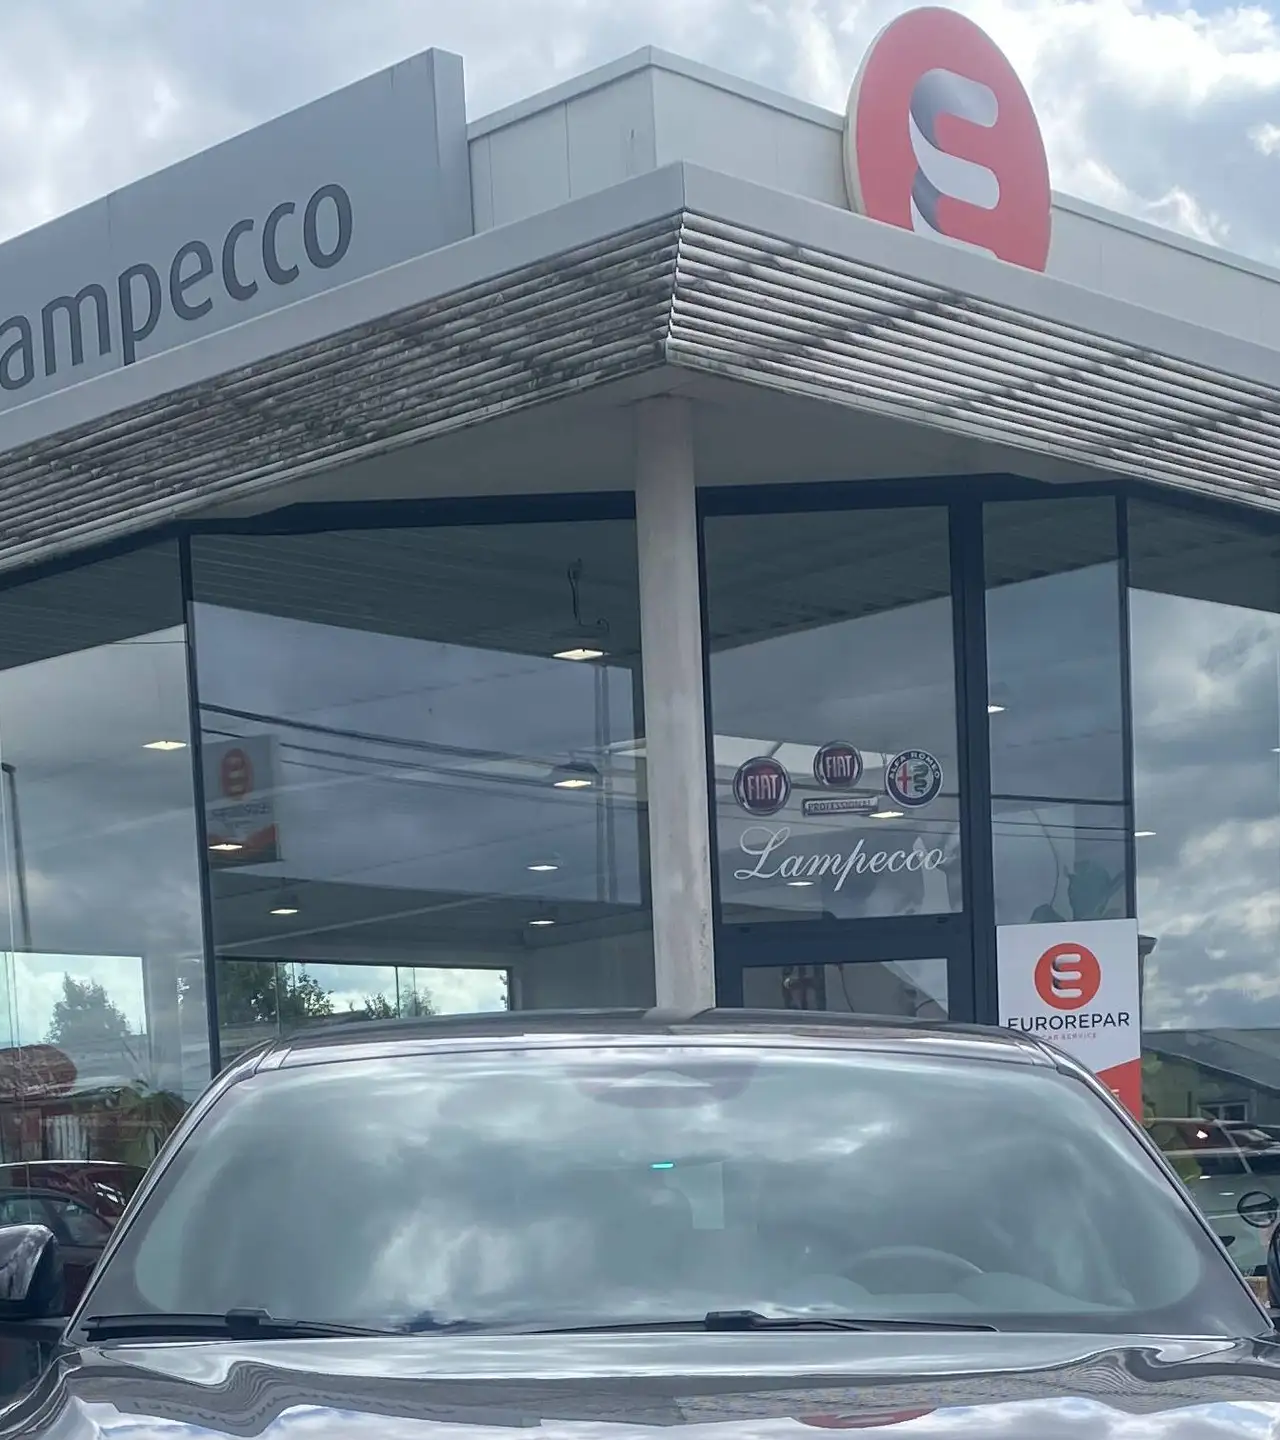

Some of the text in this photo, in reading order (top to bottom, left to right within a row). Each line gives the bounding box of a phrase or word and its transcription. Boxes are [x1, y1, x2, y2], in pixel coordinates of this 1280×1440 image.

[825, 754, 853, 778] FIAT
[889, 752, 940, 779] ALFA ROMEO
[746, 774, 780, 800] FIAT
[734, 826, 948, 892] Lampecco
[1007, 1012, 1130, 1032] EUROREPAR
